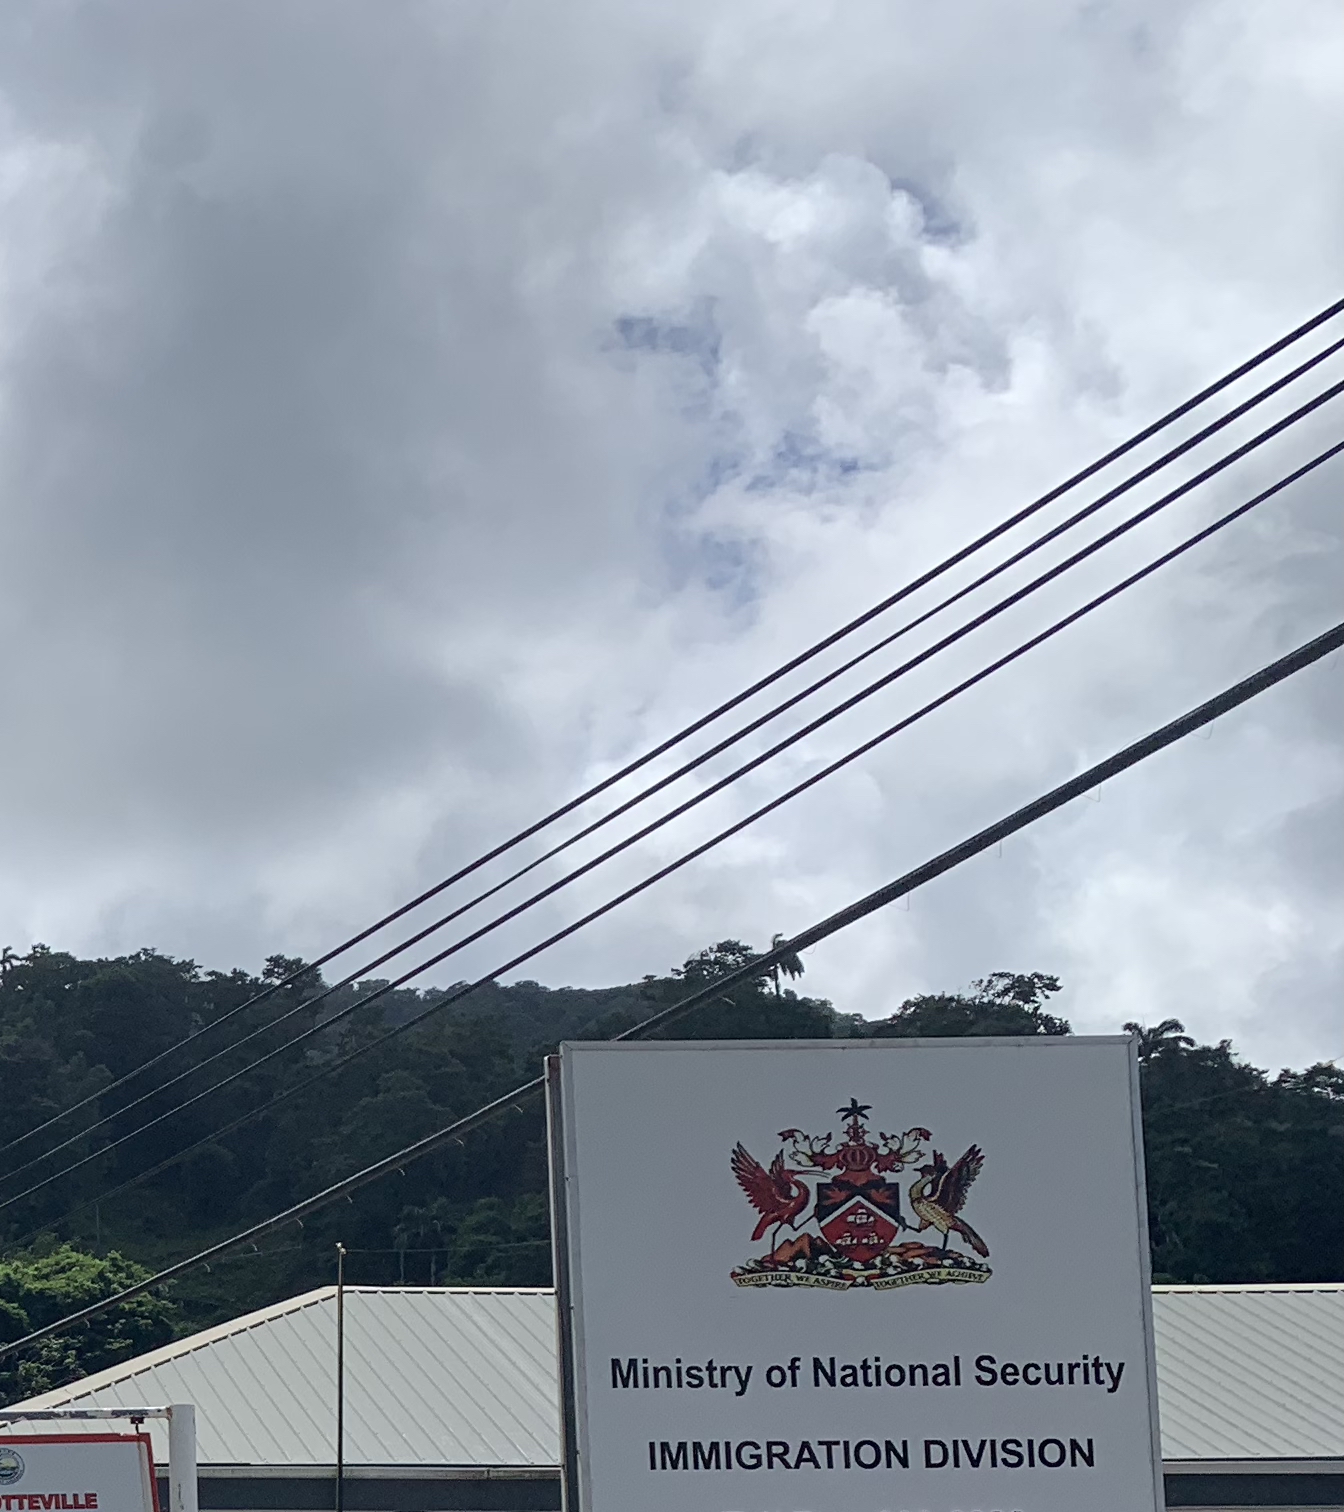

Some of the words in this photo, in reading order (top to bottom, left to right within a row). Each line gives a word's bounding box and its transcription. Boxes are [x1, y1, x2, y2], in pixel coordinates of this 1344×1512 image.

[738, 1273, 792, 1285] TOGETHER
[611, 1357, 753, 1396] Ministry
[765, 1357, 801, 1388] of
[812, 1356, 961, 1388] National
[974, 1354, 1125, 1393] Security
[649, 1440, 909, 1470] IMMIGRATION
[924, 1438, 1094, 1469] DIVISION
